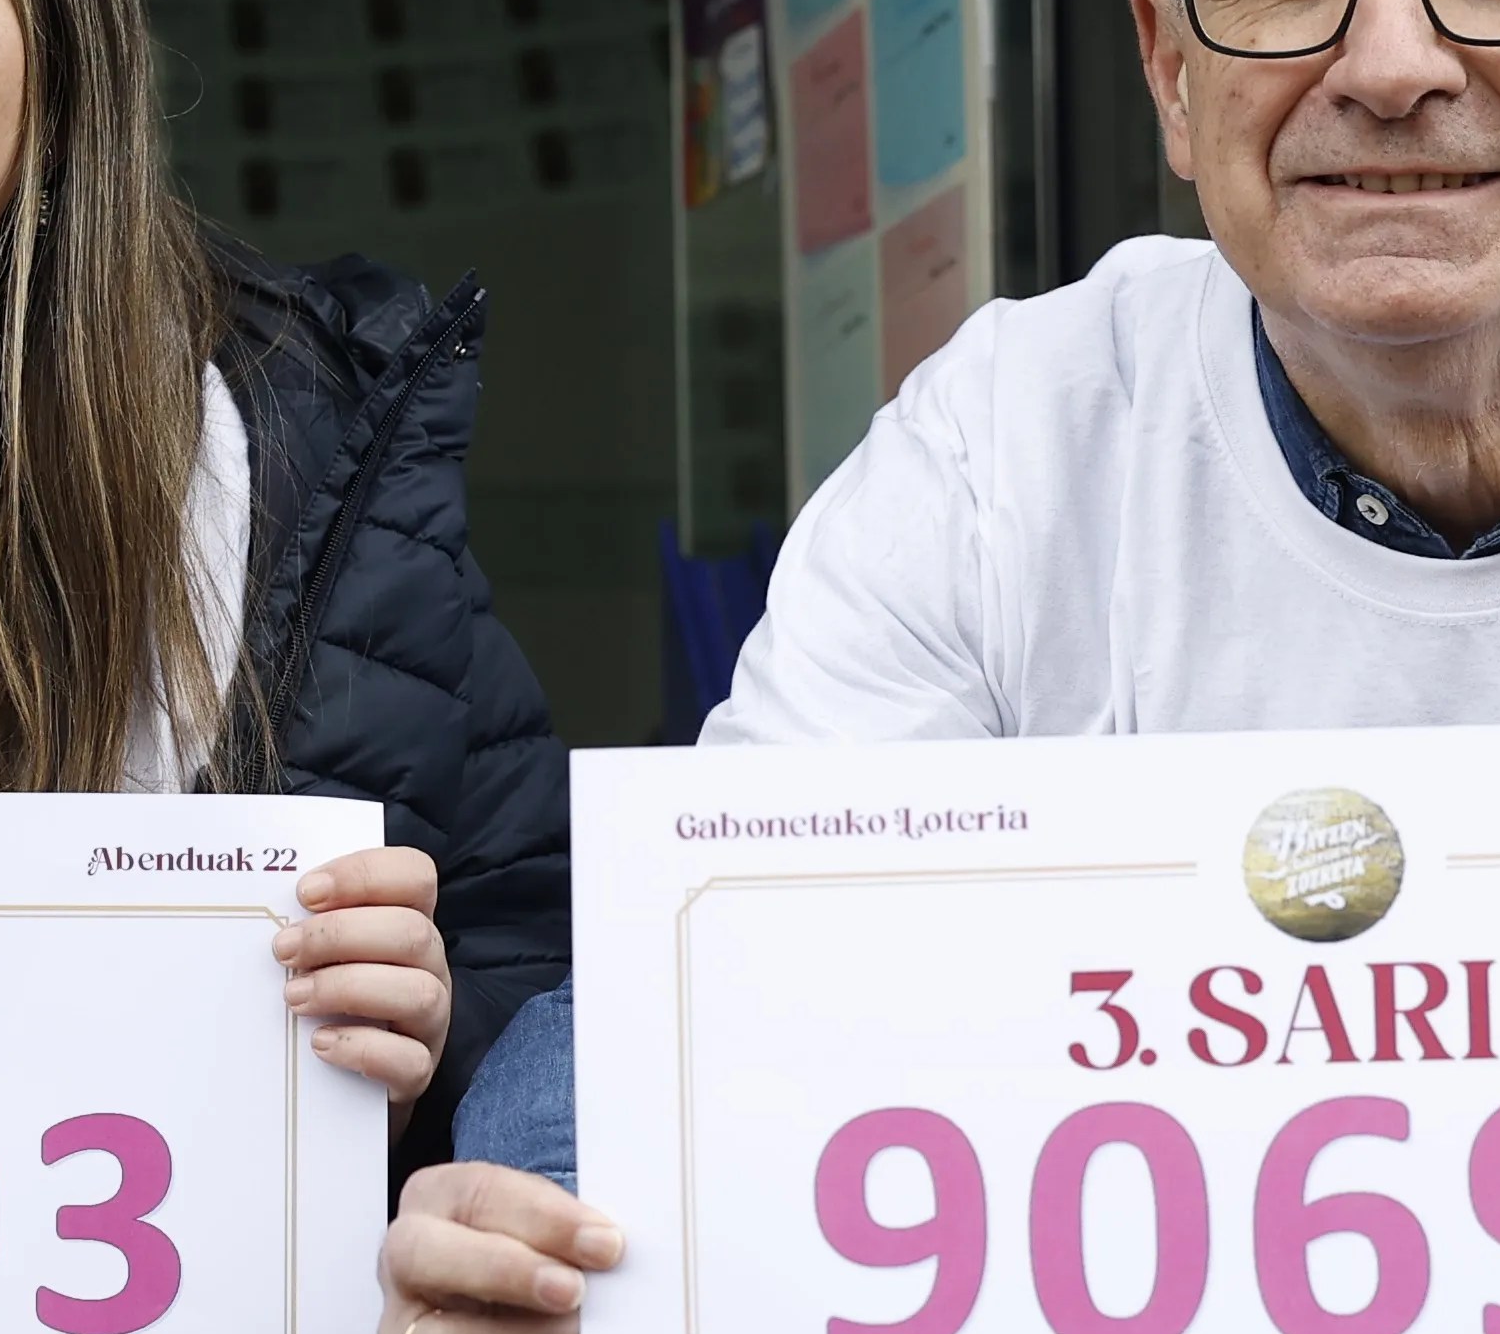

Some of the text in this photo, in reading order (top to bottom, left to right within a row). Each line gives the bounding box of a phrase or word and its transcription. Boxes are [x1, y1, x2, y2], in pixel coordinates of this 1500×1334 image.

[675, 804, 1028, 841] Gabonetako Loteria
[87, 846, 298, 877] Abenduak 22
[1068, 969, 1158, 1070] 3.
